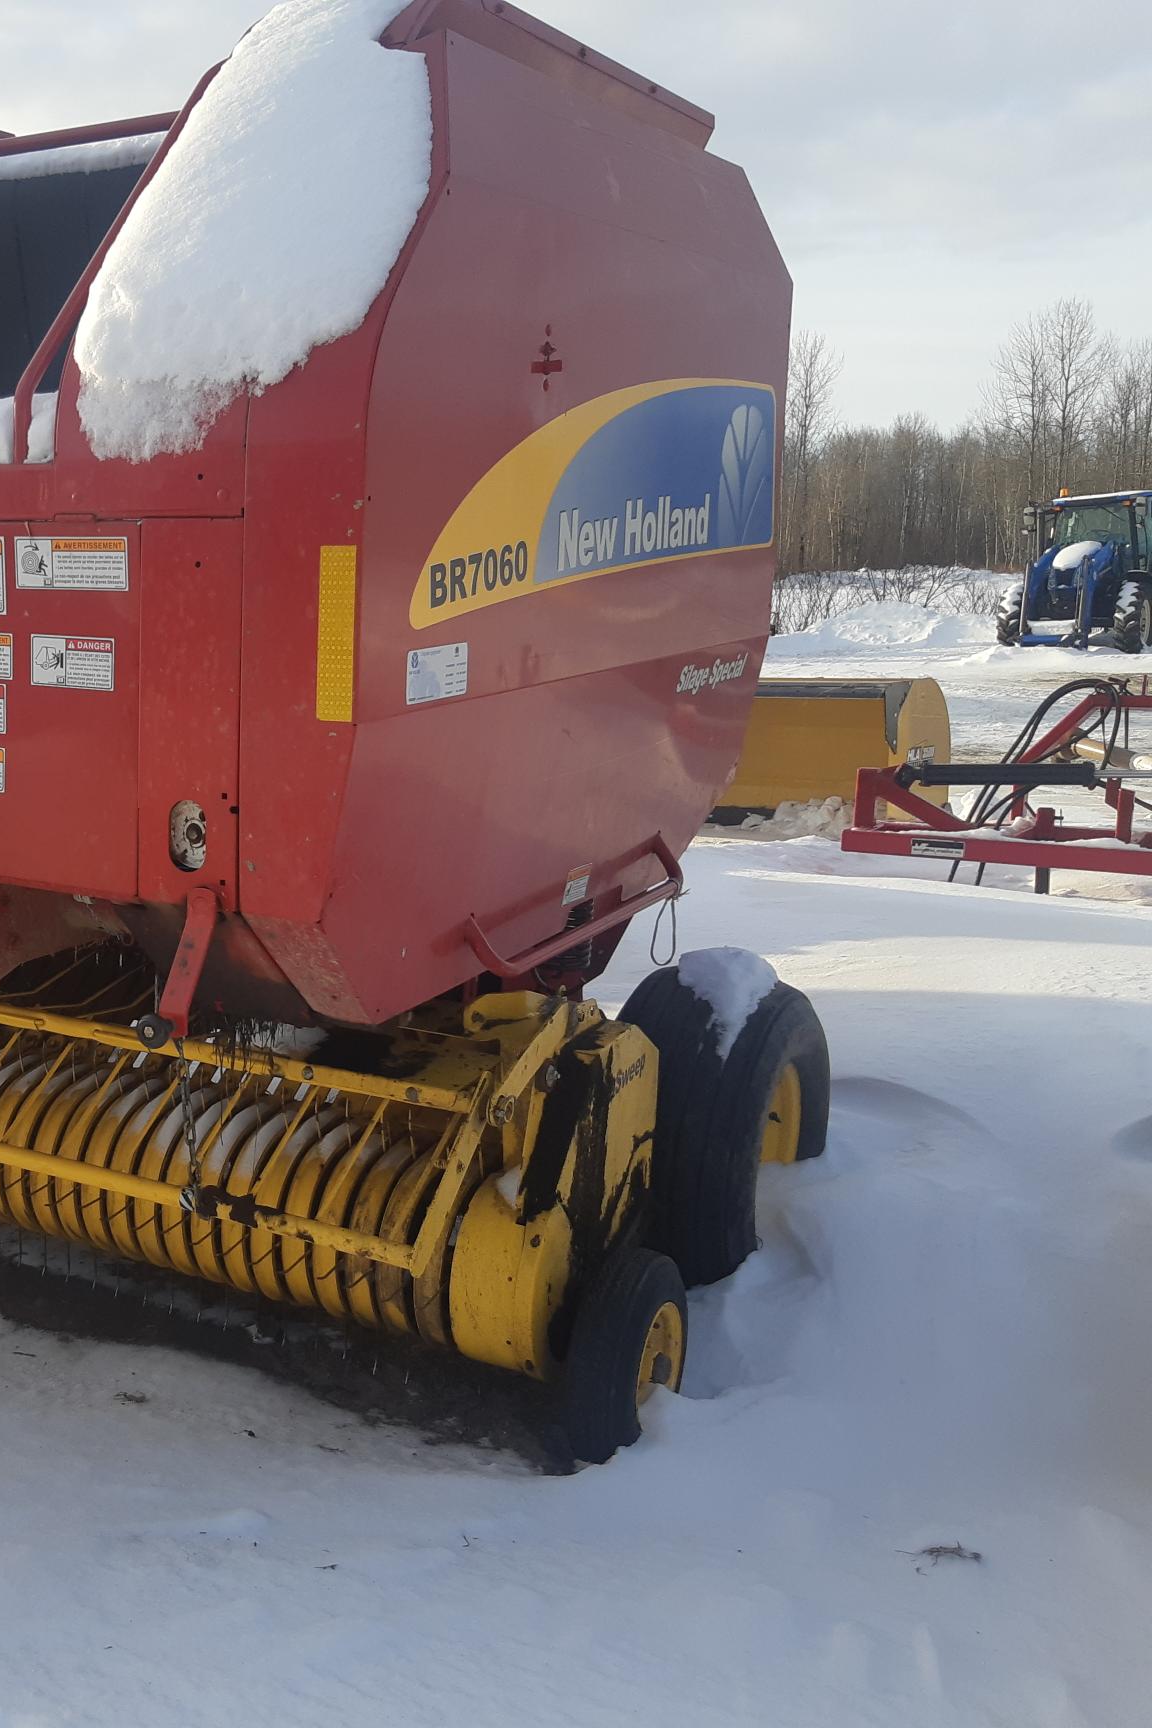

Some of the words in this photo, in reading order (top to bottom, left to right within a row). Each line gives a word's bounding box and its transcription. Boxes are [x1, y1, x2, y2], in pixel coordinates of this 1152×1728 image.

[63, 541, 122, 550] AVERTISSEMENT
[557, 509, 617, 572] New
[624, 493, 711, 557] Holland
[429, 540, 529, 609] BR7060
[77, 641, 111, 651] DANGER
[676, 664, 710, 695] Silage
[709, 651, 749, 690] Special
